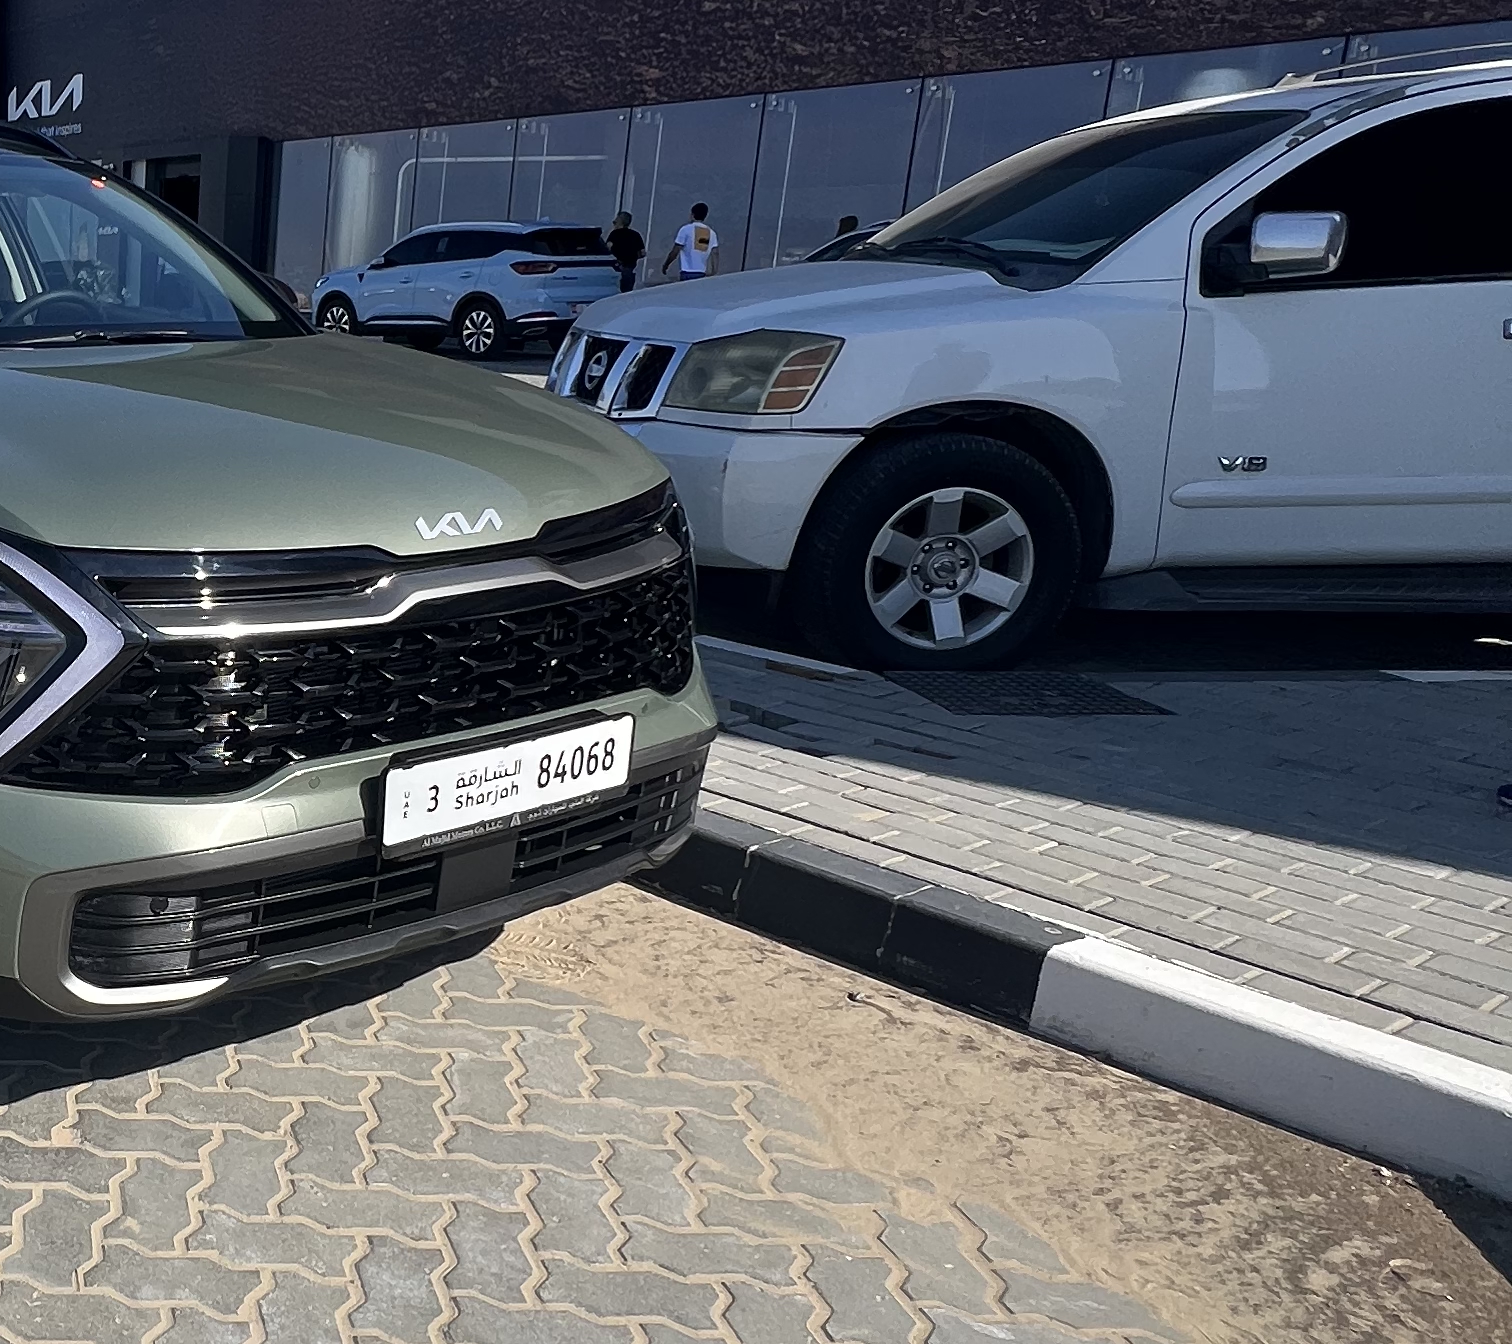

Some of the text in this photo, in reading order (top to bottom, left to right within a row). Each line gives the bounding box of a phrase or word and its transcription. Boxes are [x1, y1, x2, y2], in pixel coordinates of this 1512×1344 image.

[7, 72, 83, 123] KIA
[1217, 455, 1268, 473] V8
[413, 507, 503, 540] KIA
[454, 758, 523, 790] الشارقة
[536, 737, 616, 789] 84068
[426, 784, 440, 813] 3
[453, 780, 520, 811] Sharjah
